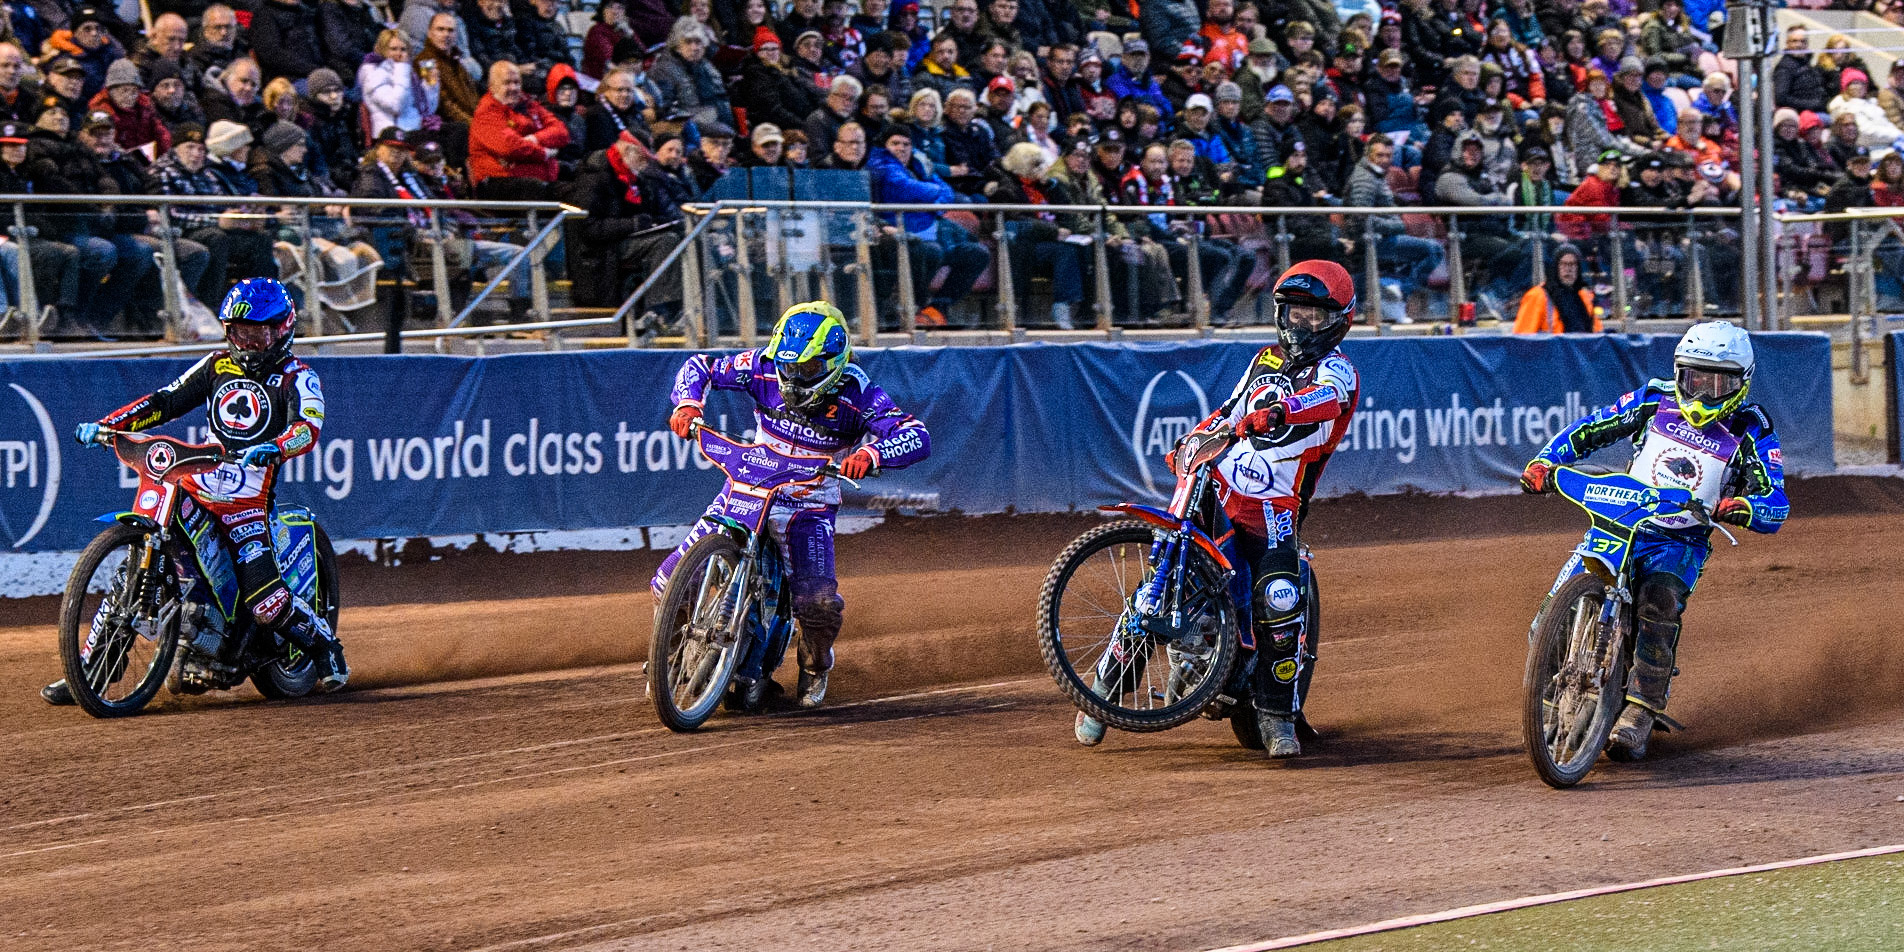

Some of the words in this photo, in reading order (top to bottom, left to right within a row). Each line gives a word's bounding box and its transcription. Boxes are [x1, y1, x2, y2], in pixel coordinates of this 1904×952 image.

[269, 375, 281, 387] 6
[217, 382, 239, 398] BELLE
[825, 404, 838, 419] 2
[1425, 393, 1507, 447] what
[1513, 391, 1600, 445] reall
[1665, 422, 1720, 452] Crendon
[368, 418, 491, 481] world
[504, 417, 603, 476] class
[880, 437, 923, 460] SHOCKS
[742, 452, 779, 469] Crendon
[729, 498, 758, 510] MERIDIAN
[731, 506, 748, 516] LIFTS
[231, 508, 264, 521] PRONAR
[808, 536, 817, 562] GROUP
[254, 588, 287, 615] CBS
[1273, 587, 1293, 601] ATPI
